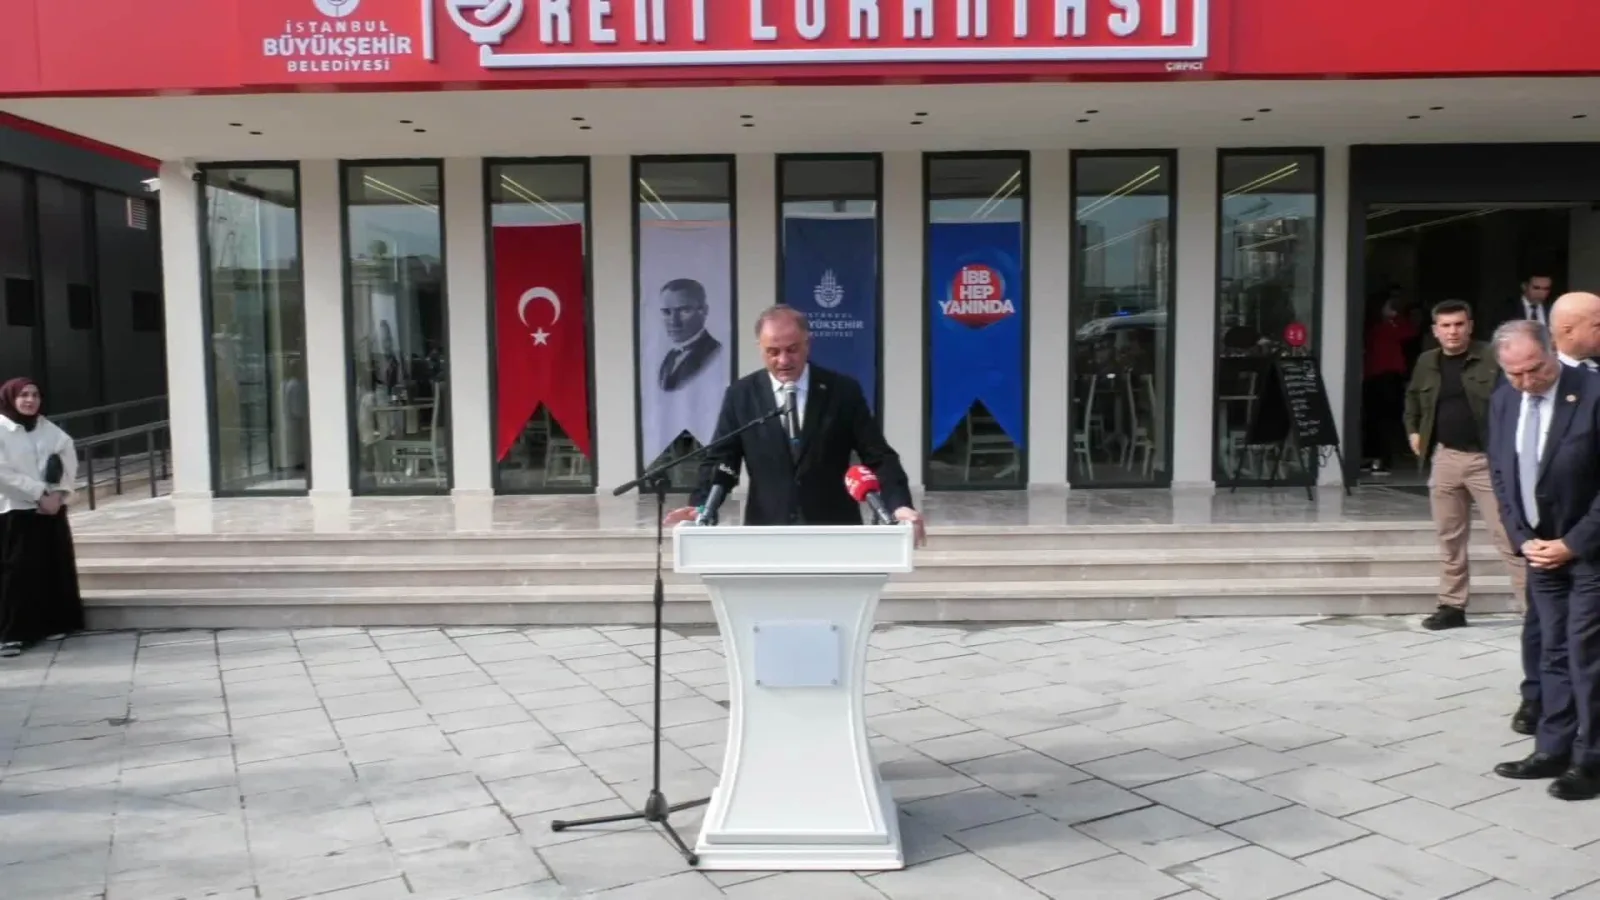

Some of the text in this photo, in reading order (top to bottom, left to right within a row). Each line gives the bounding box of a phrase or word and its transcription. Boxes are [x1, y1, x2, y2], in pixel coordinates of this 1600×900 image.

[285, 20, 390, 33] İSTANBUL
[263, 33, 412, 57] BÜYÜKŞEHİR
[287, 58, 390, 72] BELEDİYESİ
[962, 266, 991, 285] İBB
[959, 285, 994, 300] HEP
[938, 299, 1015, 315] YANINDA
[807, 319, 865, 330] YÜKŞEHİR
